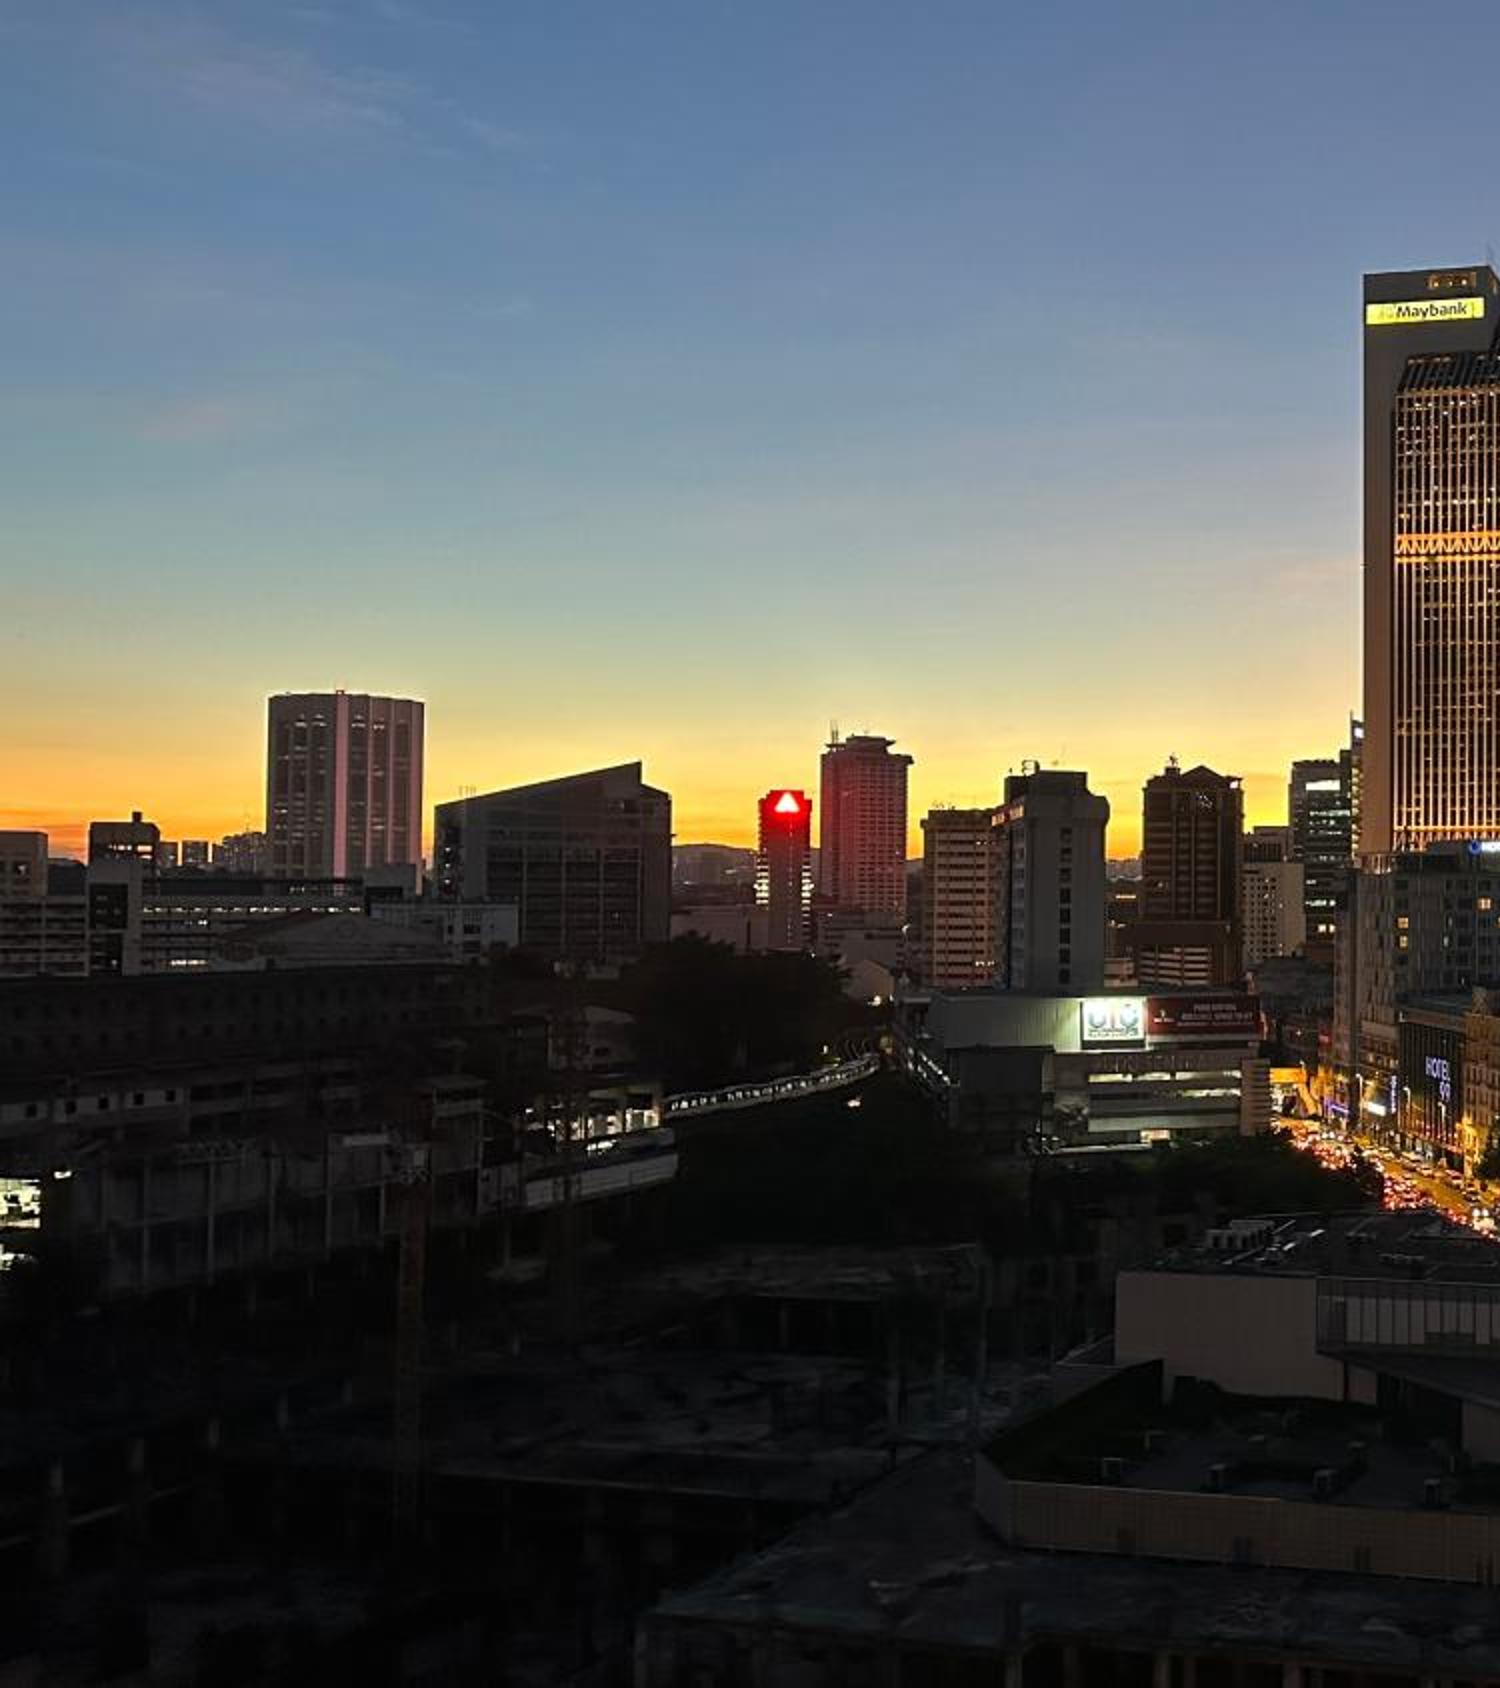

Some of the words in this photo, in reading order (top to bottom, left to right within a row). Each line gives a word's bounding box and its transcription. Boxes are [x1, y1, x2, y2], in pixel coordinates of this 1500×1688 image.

[1396, 302, 1467, 318] Maybank
[1425, 1056, 1451, 1081] HOTEL
[1439, 1082, 1451, 1102] 99
